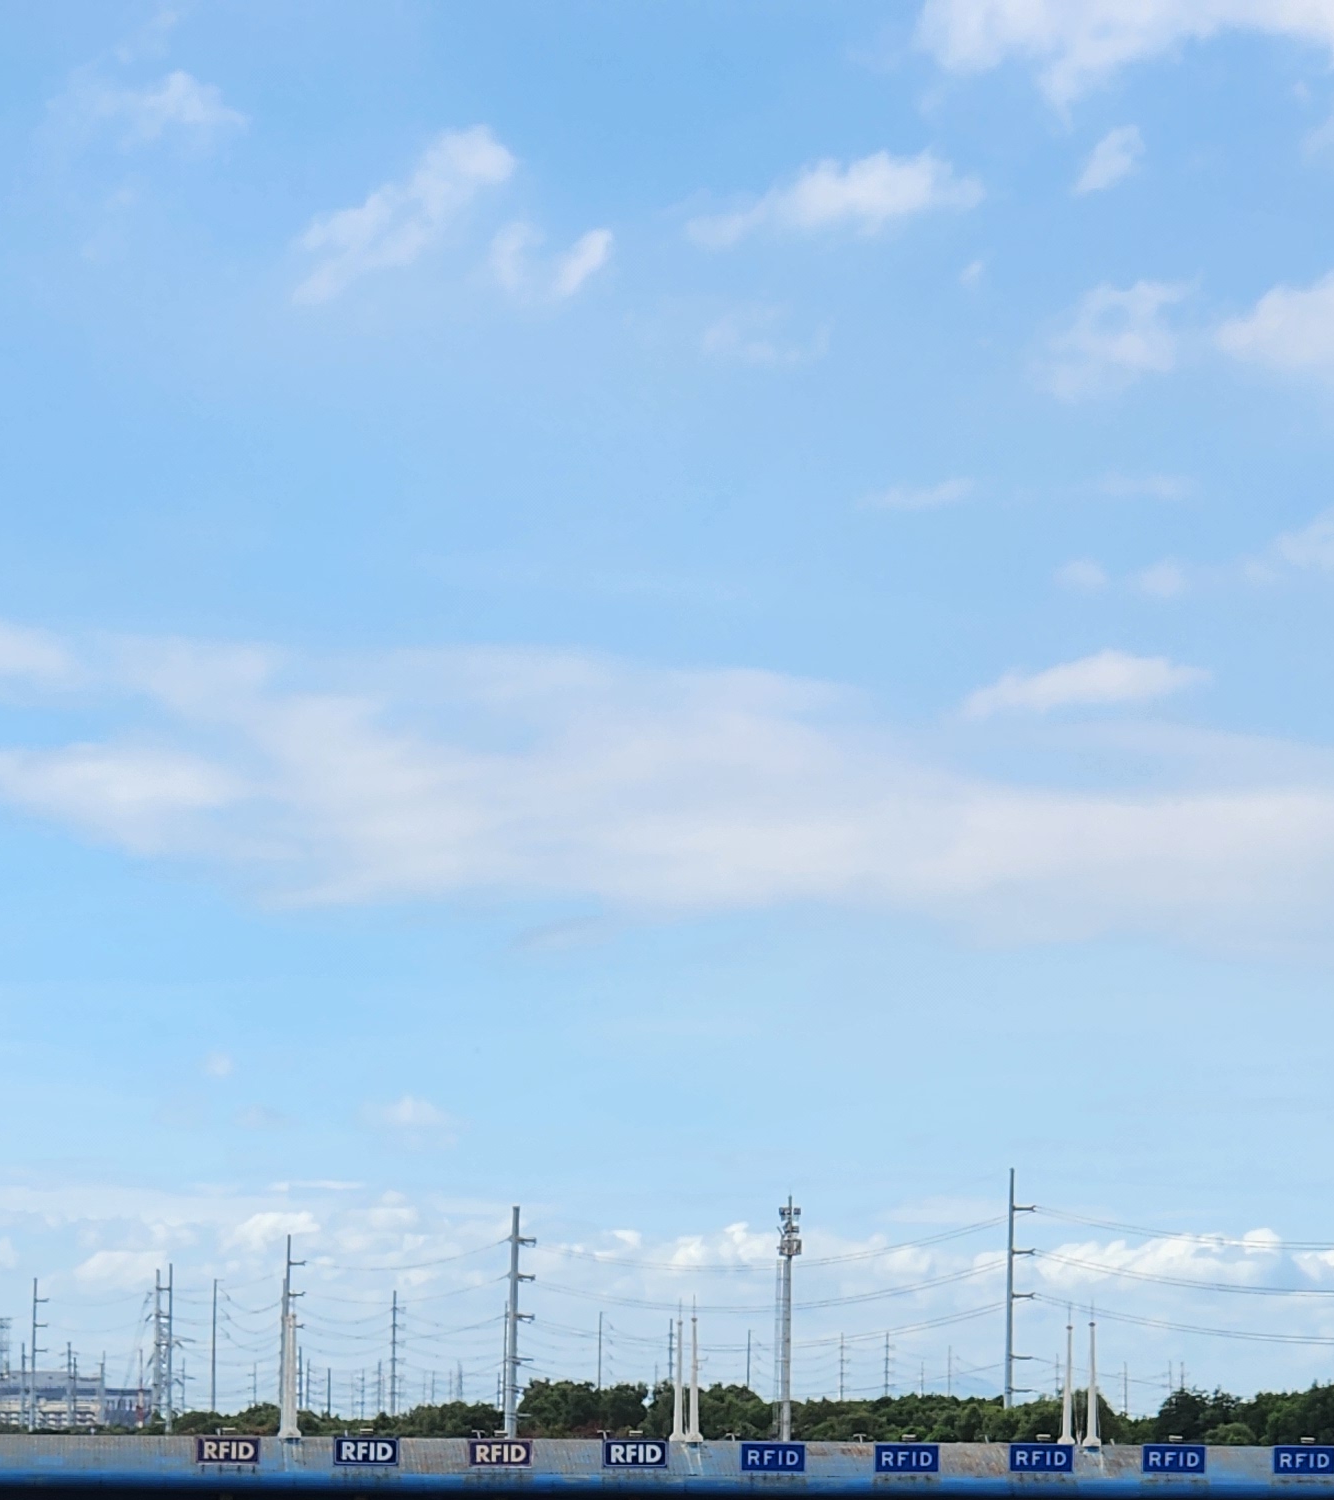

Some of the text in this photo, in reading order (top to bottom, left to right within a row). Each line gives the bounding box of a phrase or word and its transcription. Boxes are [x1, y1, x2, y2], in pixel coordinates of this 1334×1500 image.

[202, 1441, 255, 1461] RFID
[340, 1441, 394, 1461] RFID
[474, 1443, 527, 1463] RFID
[610, 1443, 663, 1463] RFID
[747, 1449, 799, 1466] RFID
[881, 1450, 934, 1467] RFID
[1015, 1450, 1067, 1467] RFID
[1148, 1451, 1200, 1468] RFID
[1279, 1453, 1330, 1469] RFID
